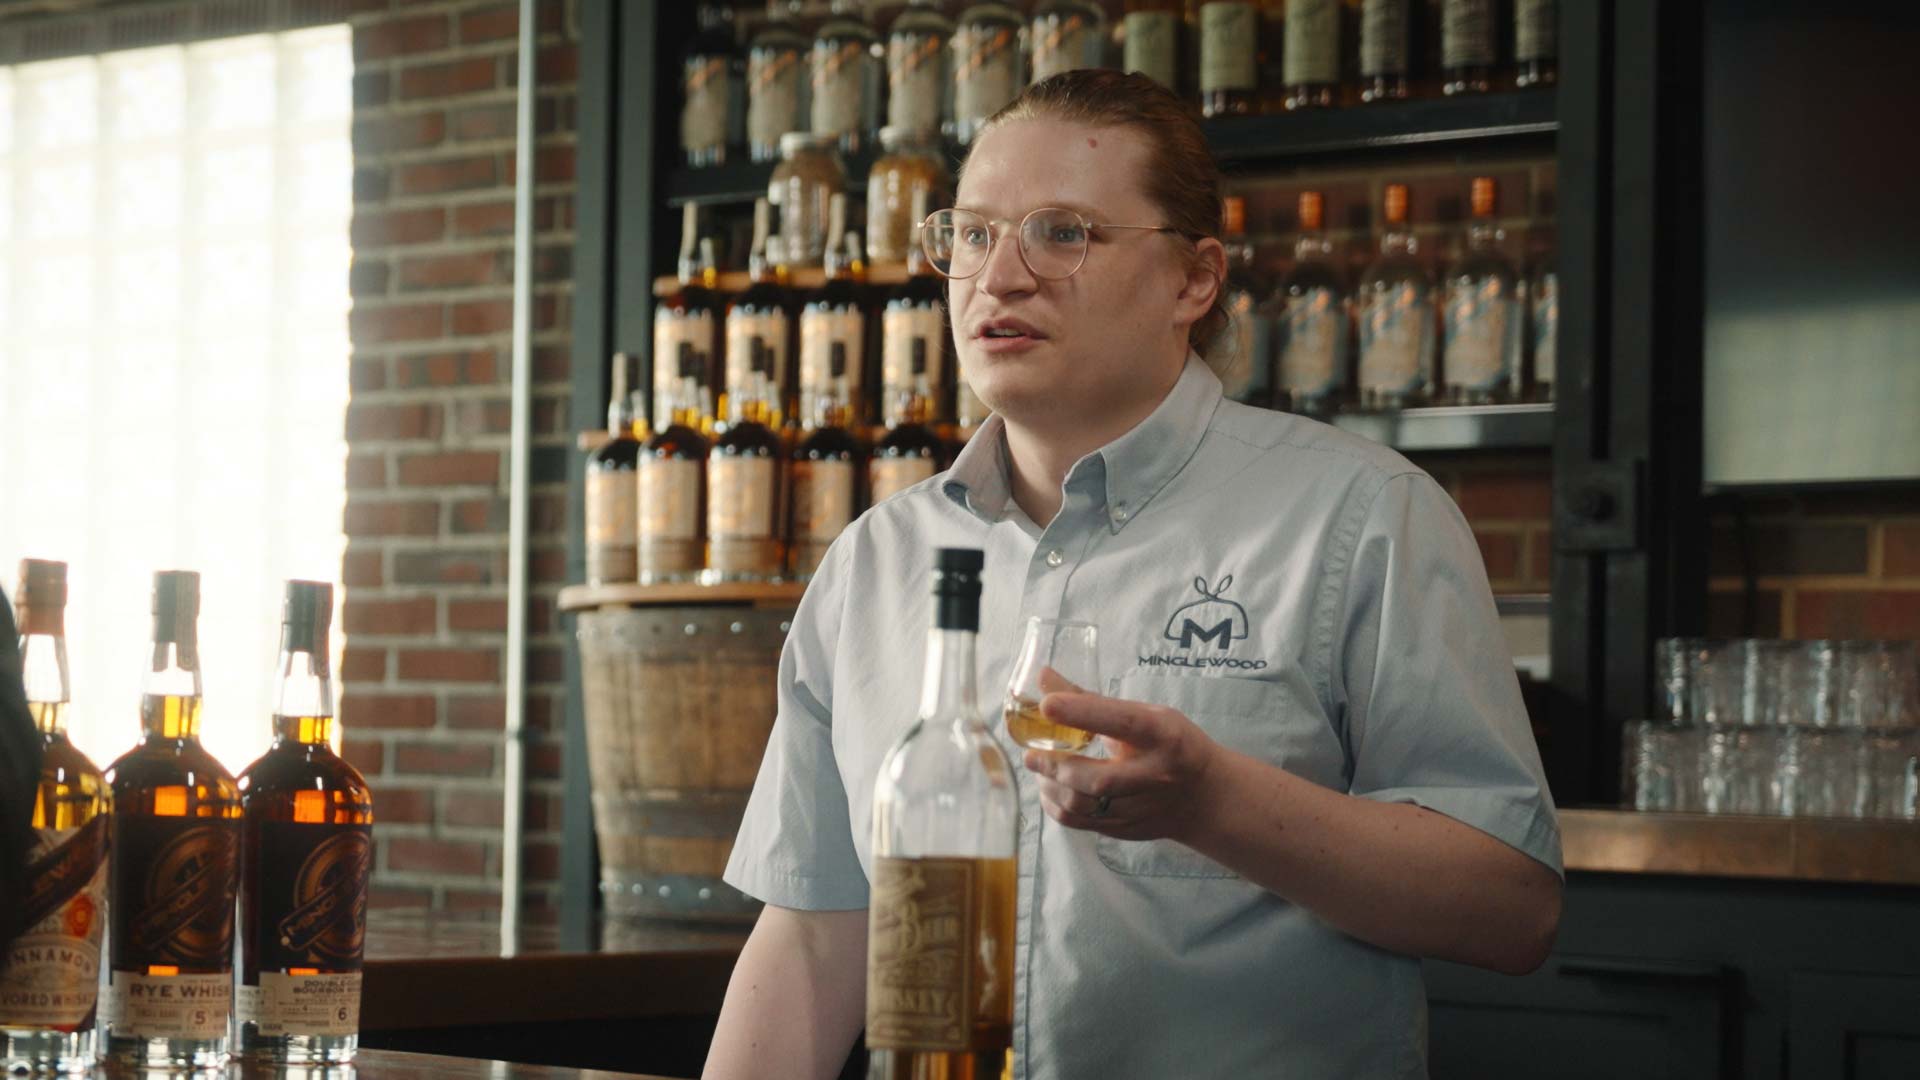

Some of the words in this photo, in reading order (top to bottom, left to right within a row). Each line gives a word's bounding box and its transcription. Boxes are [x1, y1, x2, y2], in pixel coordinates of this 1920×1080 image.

[1180, 618, 1232, 650] M
[1138, 655, 1268, 670] MINGLEWOOD
[130, 984, 173, 997] RYE
[194, 1010, 207, 1025] 5
[338, 1007, 348, 1020] 6
